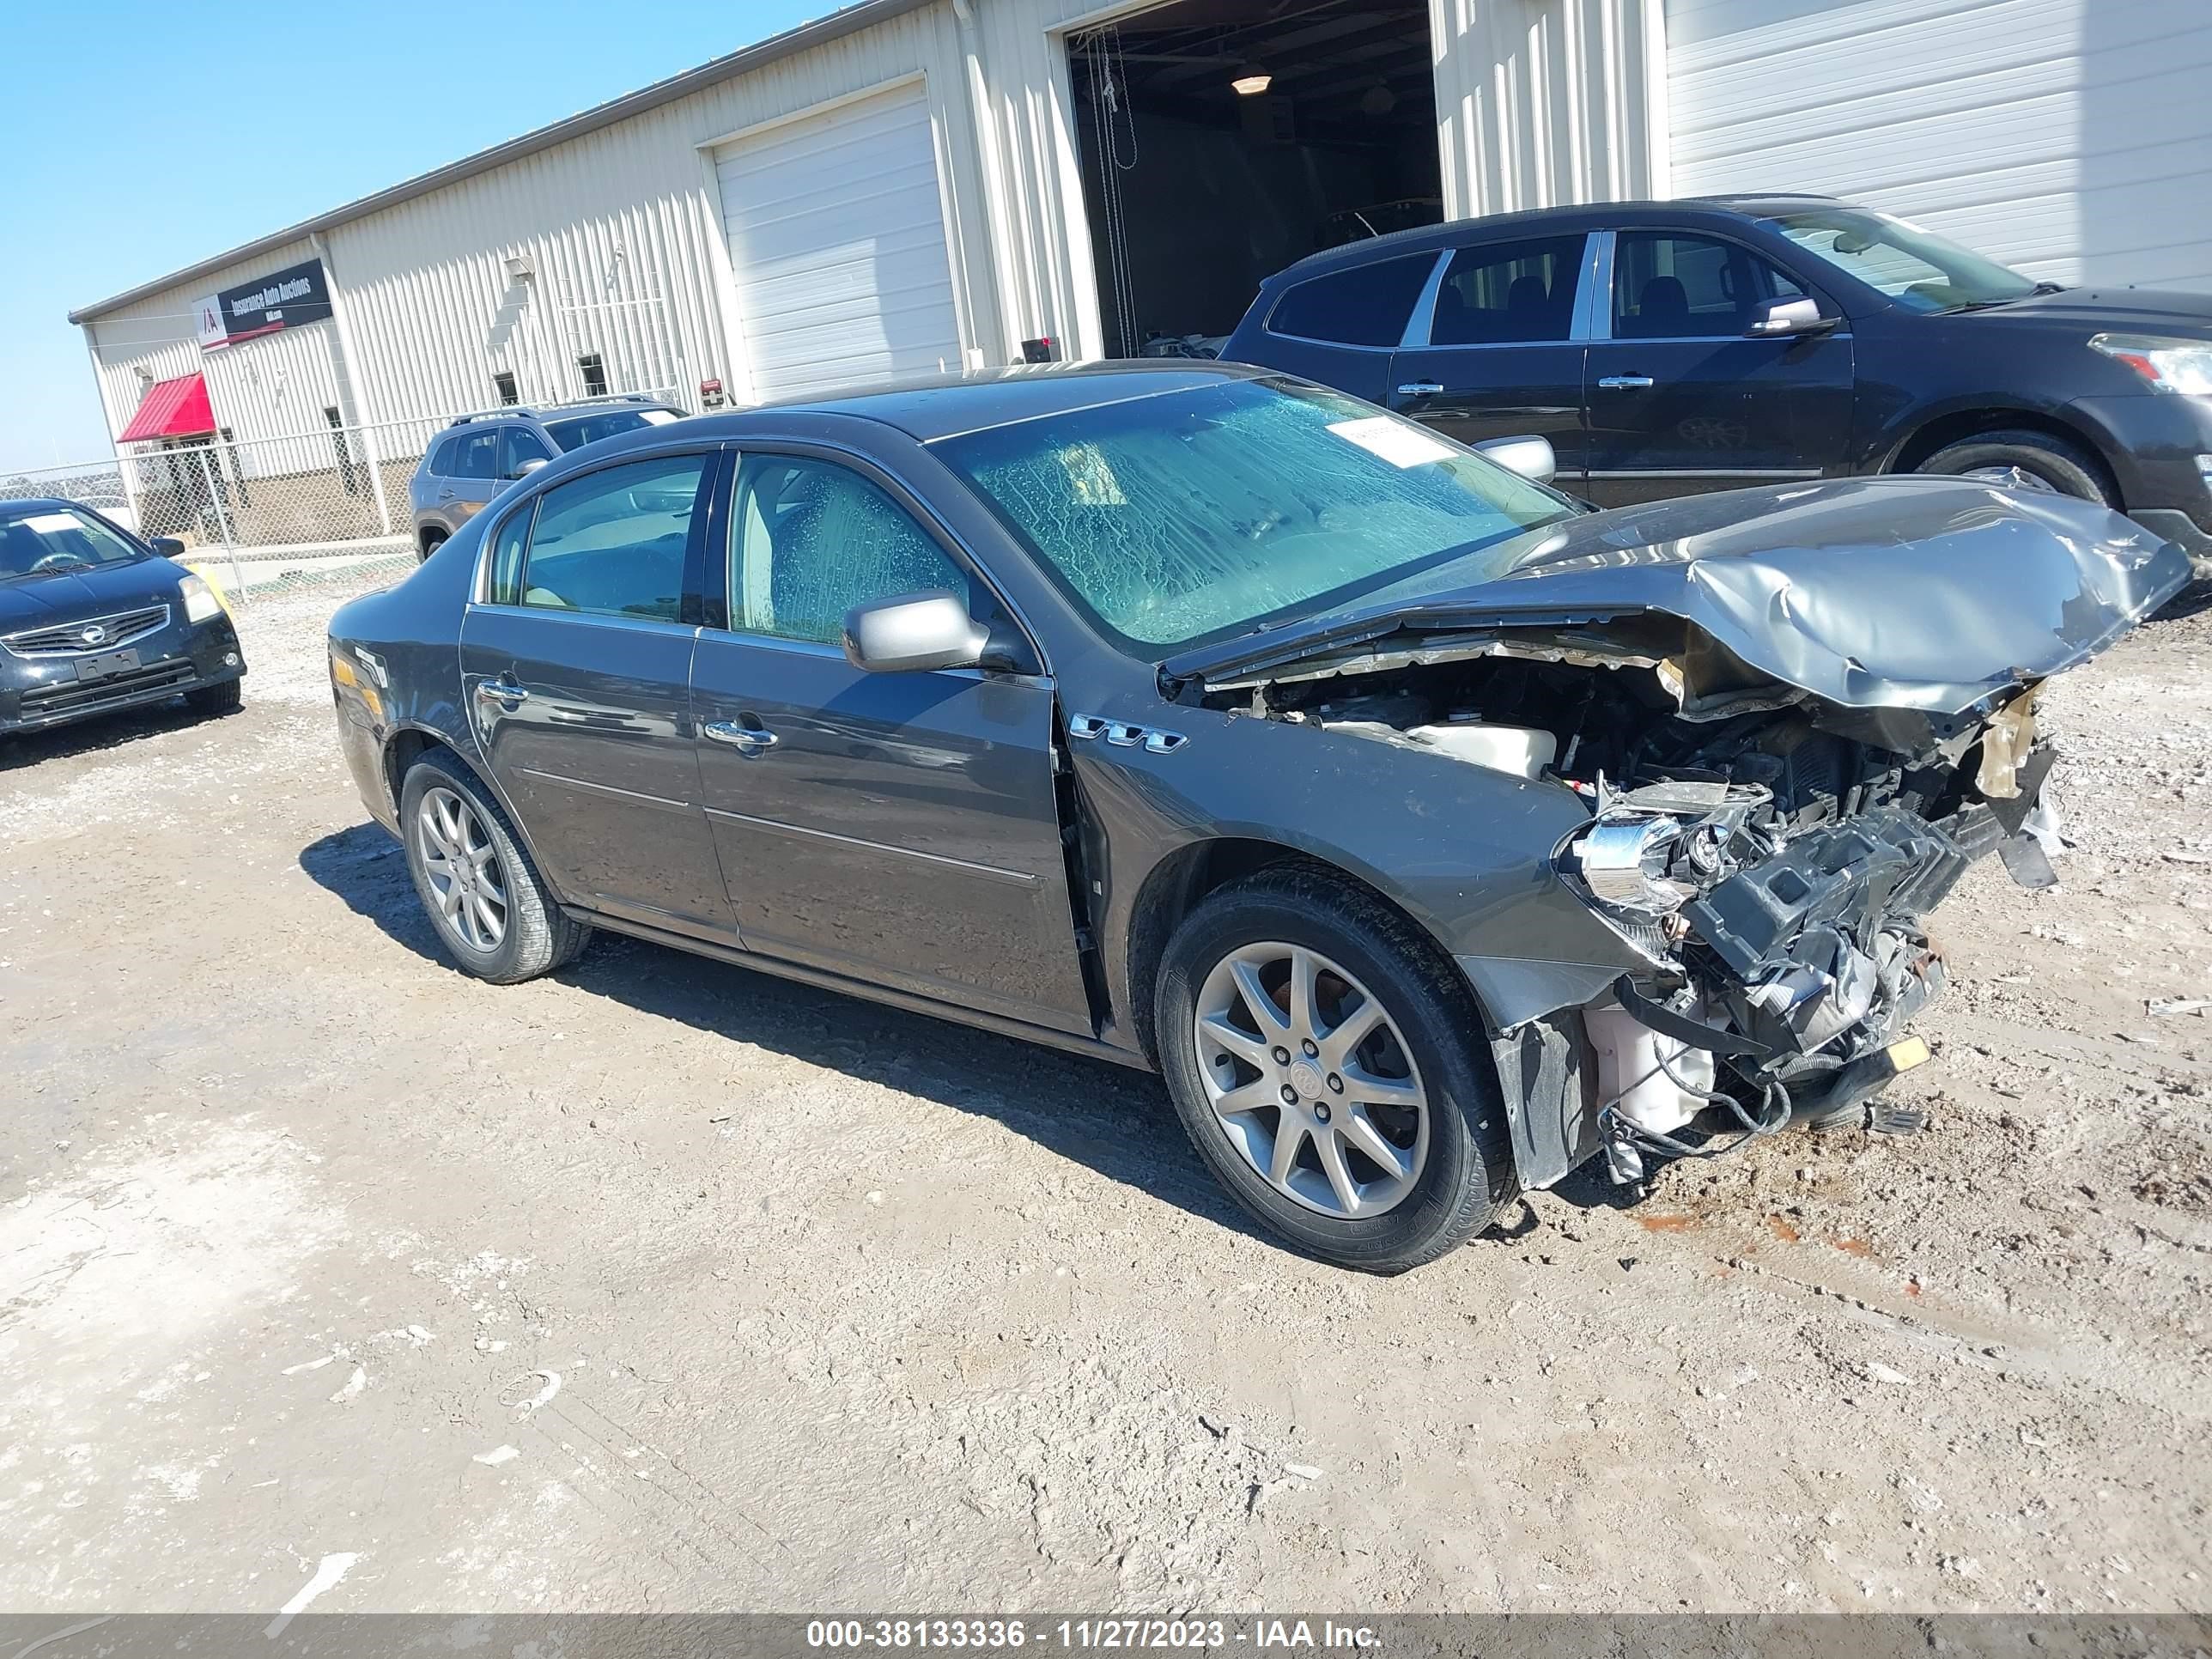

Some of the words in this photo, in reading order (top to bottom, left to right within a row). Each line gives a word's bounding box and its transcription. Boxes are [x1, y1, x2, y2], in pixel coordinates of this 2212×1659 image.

[231, 293, 264, 317] Insurance
[263, 287, 281, 307] Auto
[278, 277, 311, 301] Auctions
